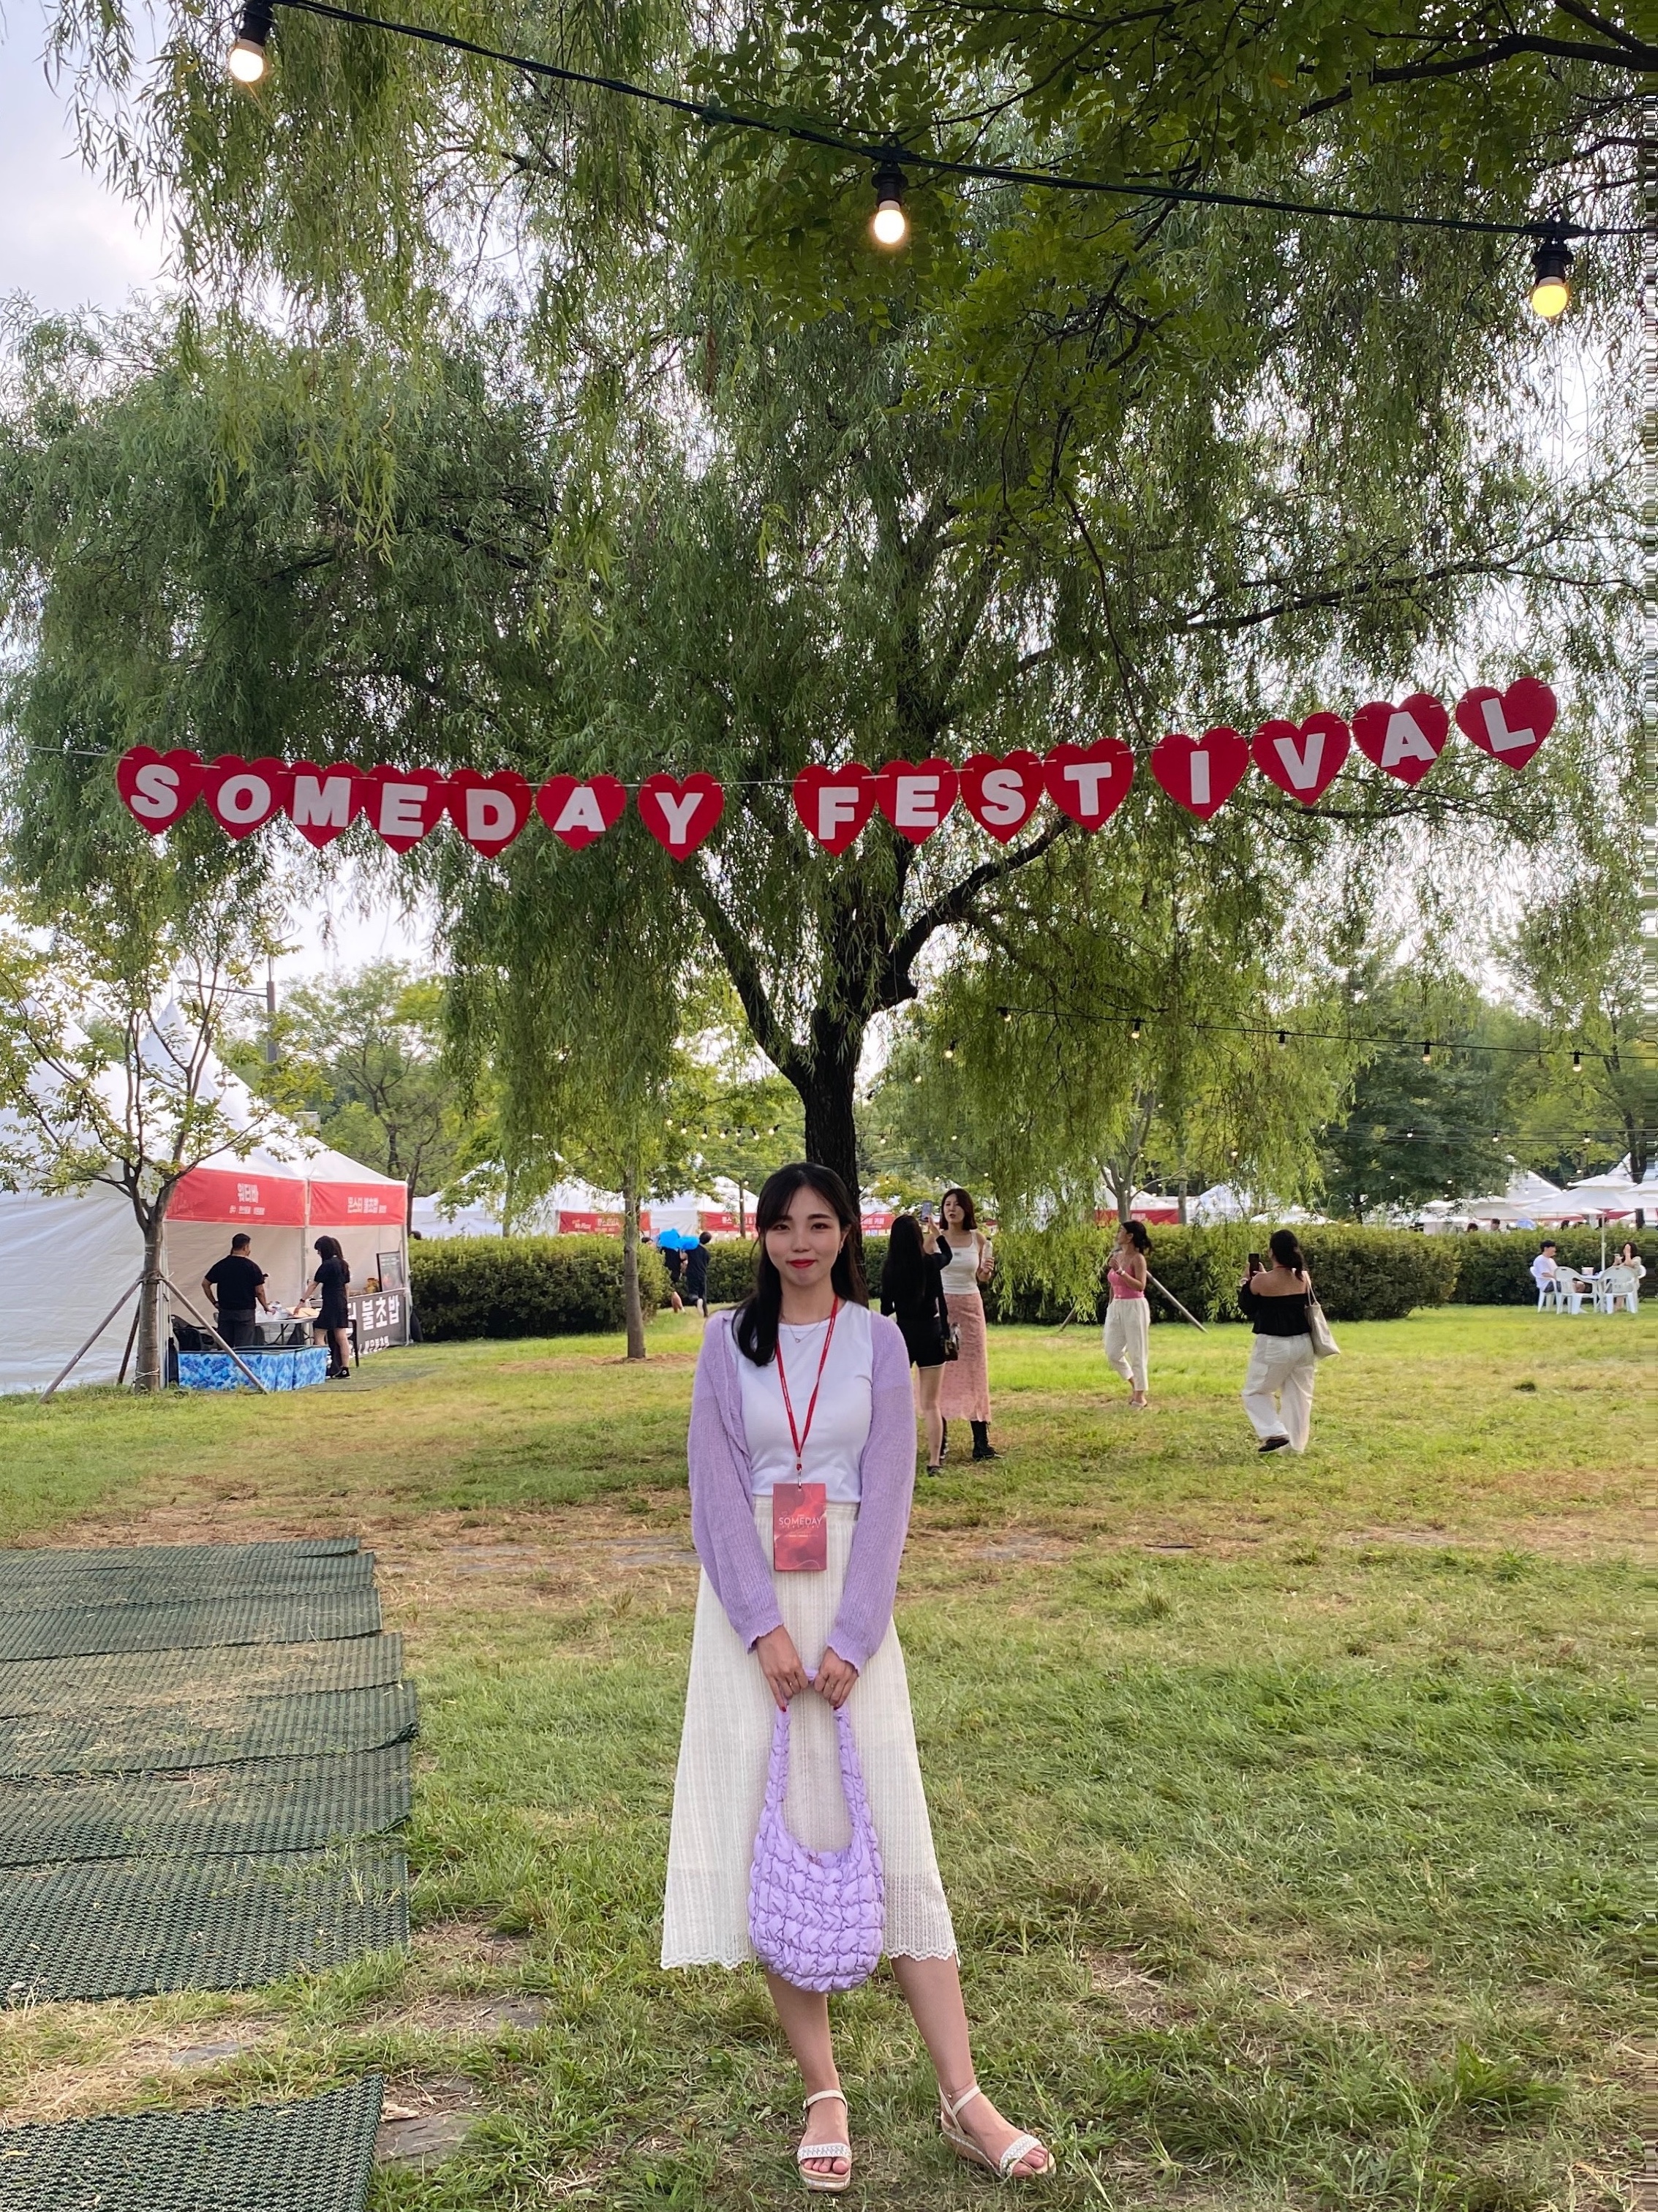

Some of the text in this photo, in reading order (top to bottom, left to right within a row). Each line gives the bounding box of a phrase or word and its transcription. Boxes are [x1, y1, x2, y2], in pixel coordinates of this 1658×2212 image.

[130, 697, 1537, 845] SOMEDAY FESTIVAL
[361, 1294, 399, 1331] 불초밥
[778, 1517, 823, 1525] SOMEDAY
